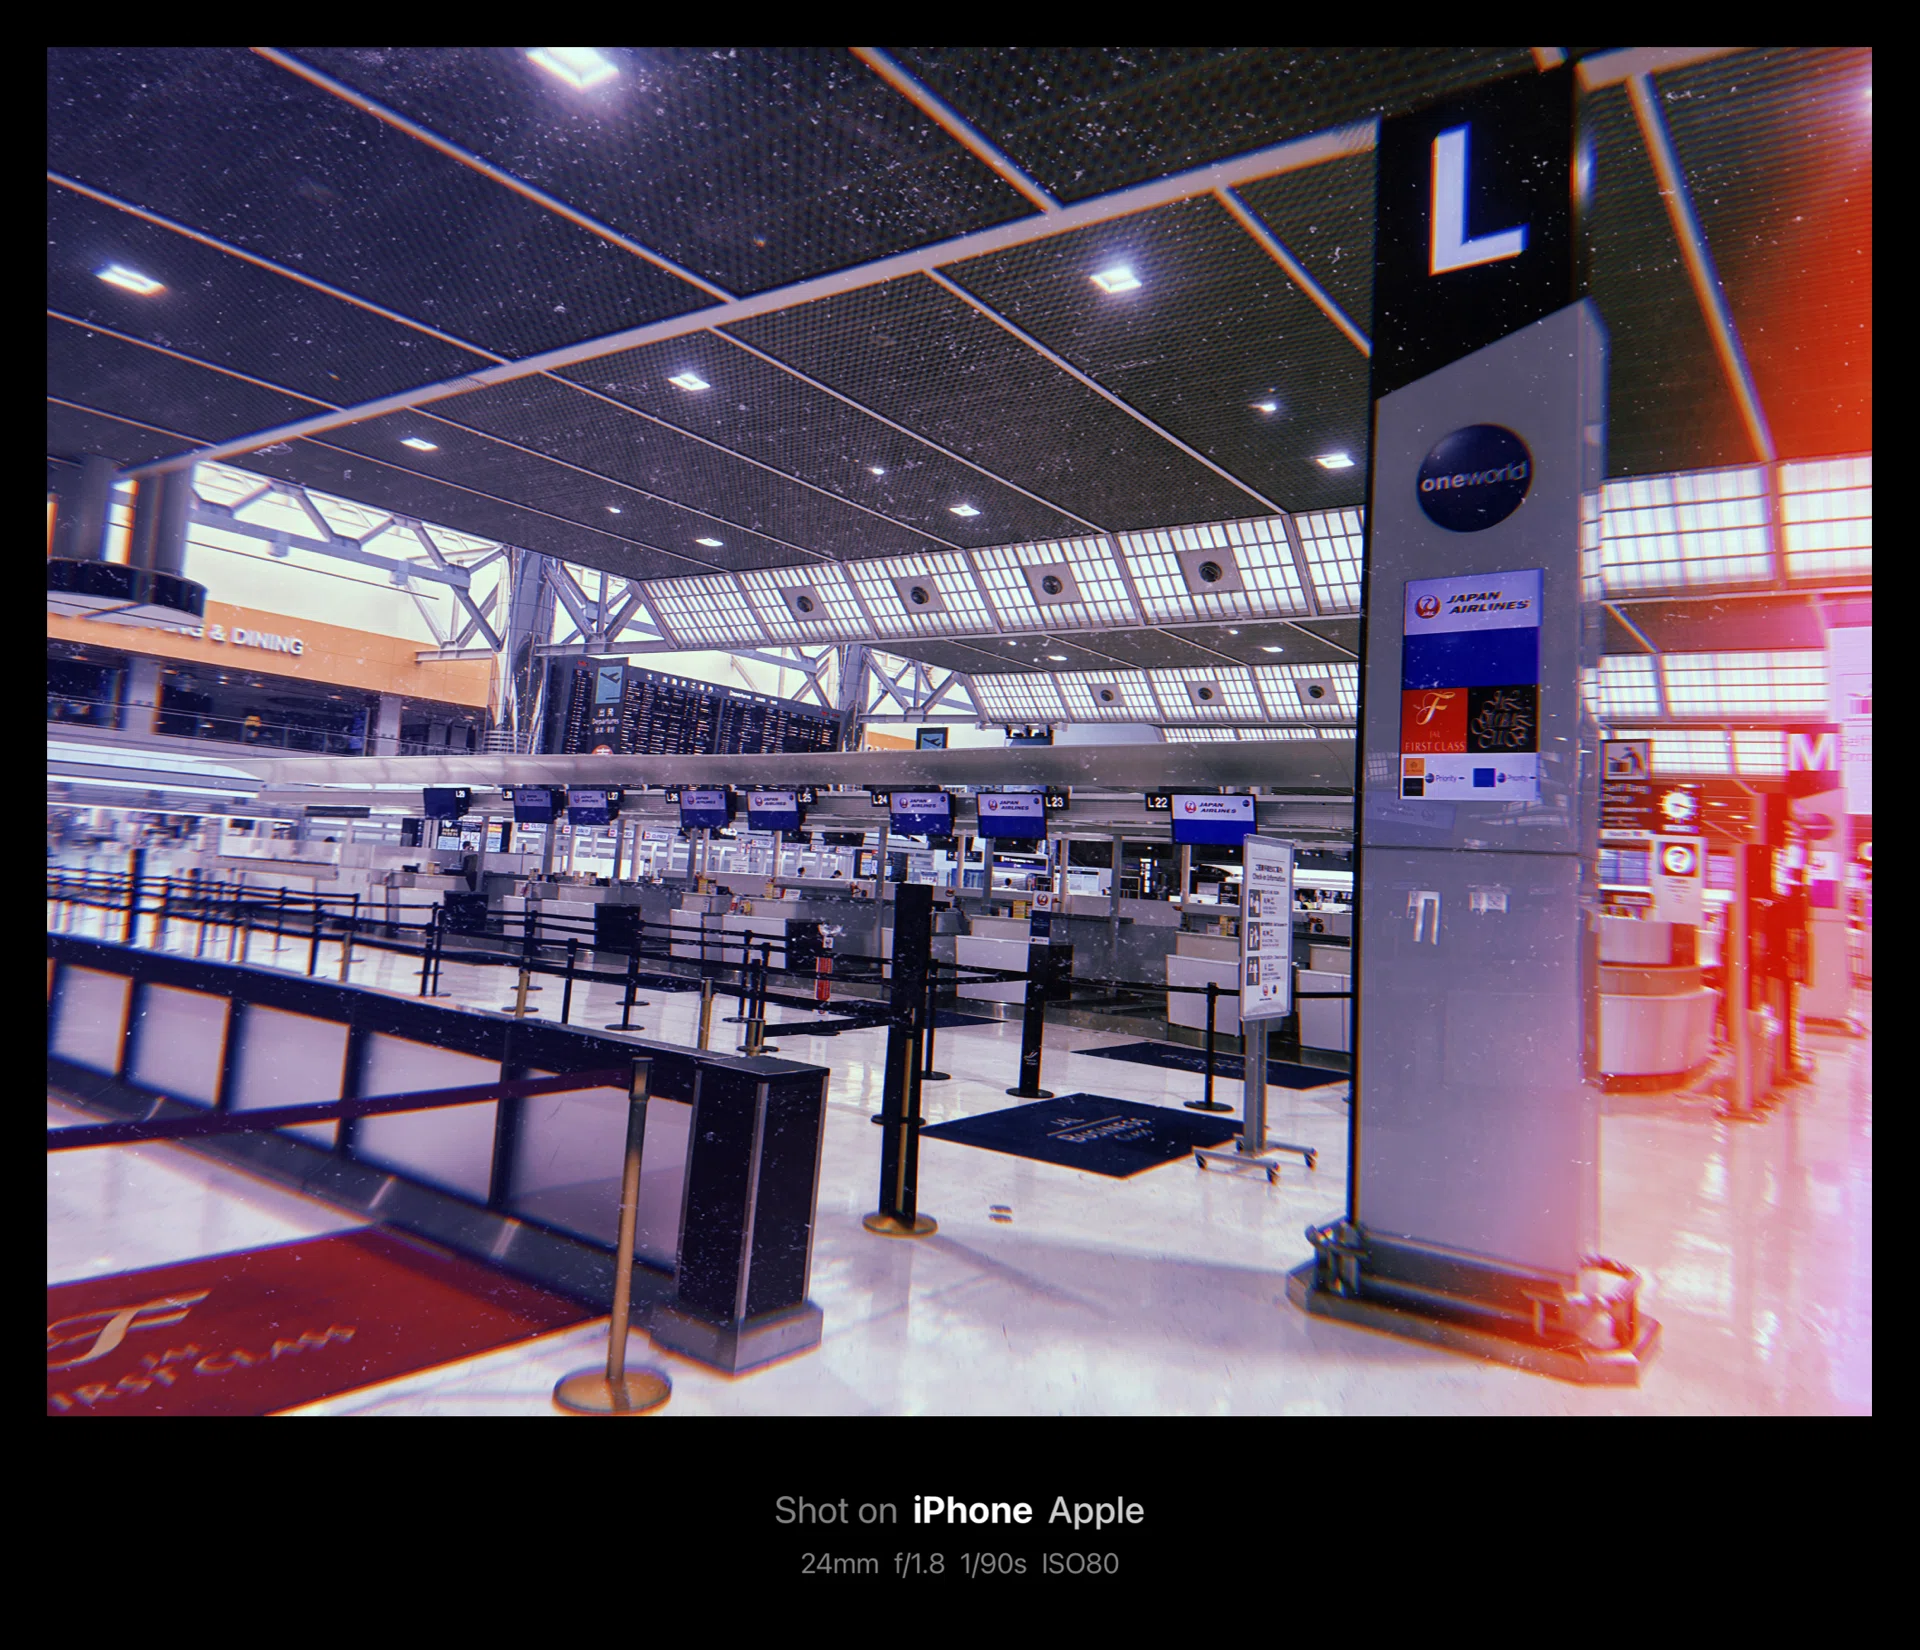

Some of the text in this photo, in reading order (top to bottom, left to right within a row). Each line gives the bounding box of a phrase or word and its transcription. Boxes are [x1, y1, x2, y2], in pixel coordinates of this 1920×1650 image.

[1429, 121, 1529, 276] L
[1421, 460, 1528, 492] oneworld
[1446, 591, 1502, 604] JAPAN
[1448, 600, 1531, 614] AIRLINES
[208, 624, 226, 642] &
[231, 627, 304, 655] DINING
[1405, 741, 1466, 752] FIRST CLASS
[1787, 733, 1838, 771] M
[1435, 774, 1458, 784] Priority
[607, 791, 619, 800] L27
[798, 793, 812, 803] L25
[873, 794, 888, 805] L24
[1045, 796, 1064, 808] L23
[1147, 796, 1168, 808] L22
